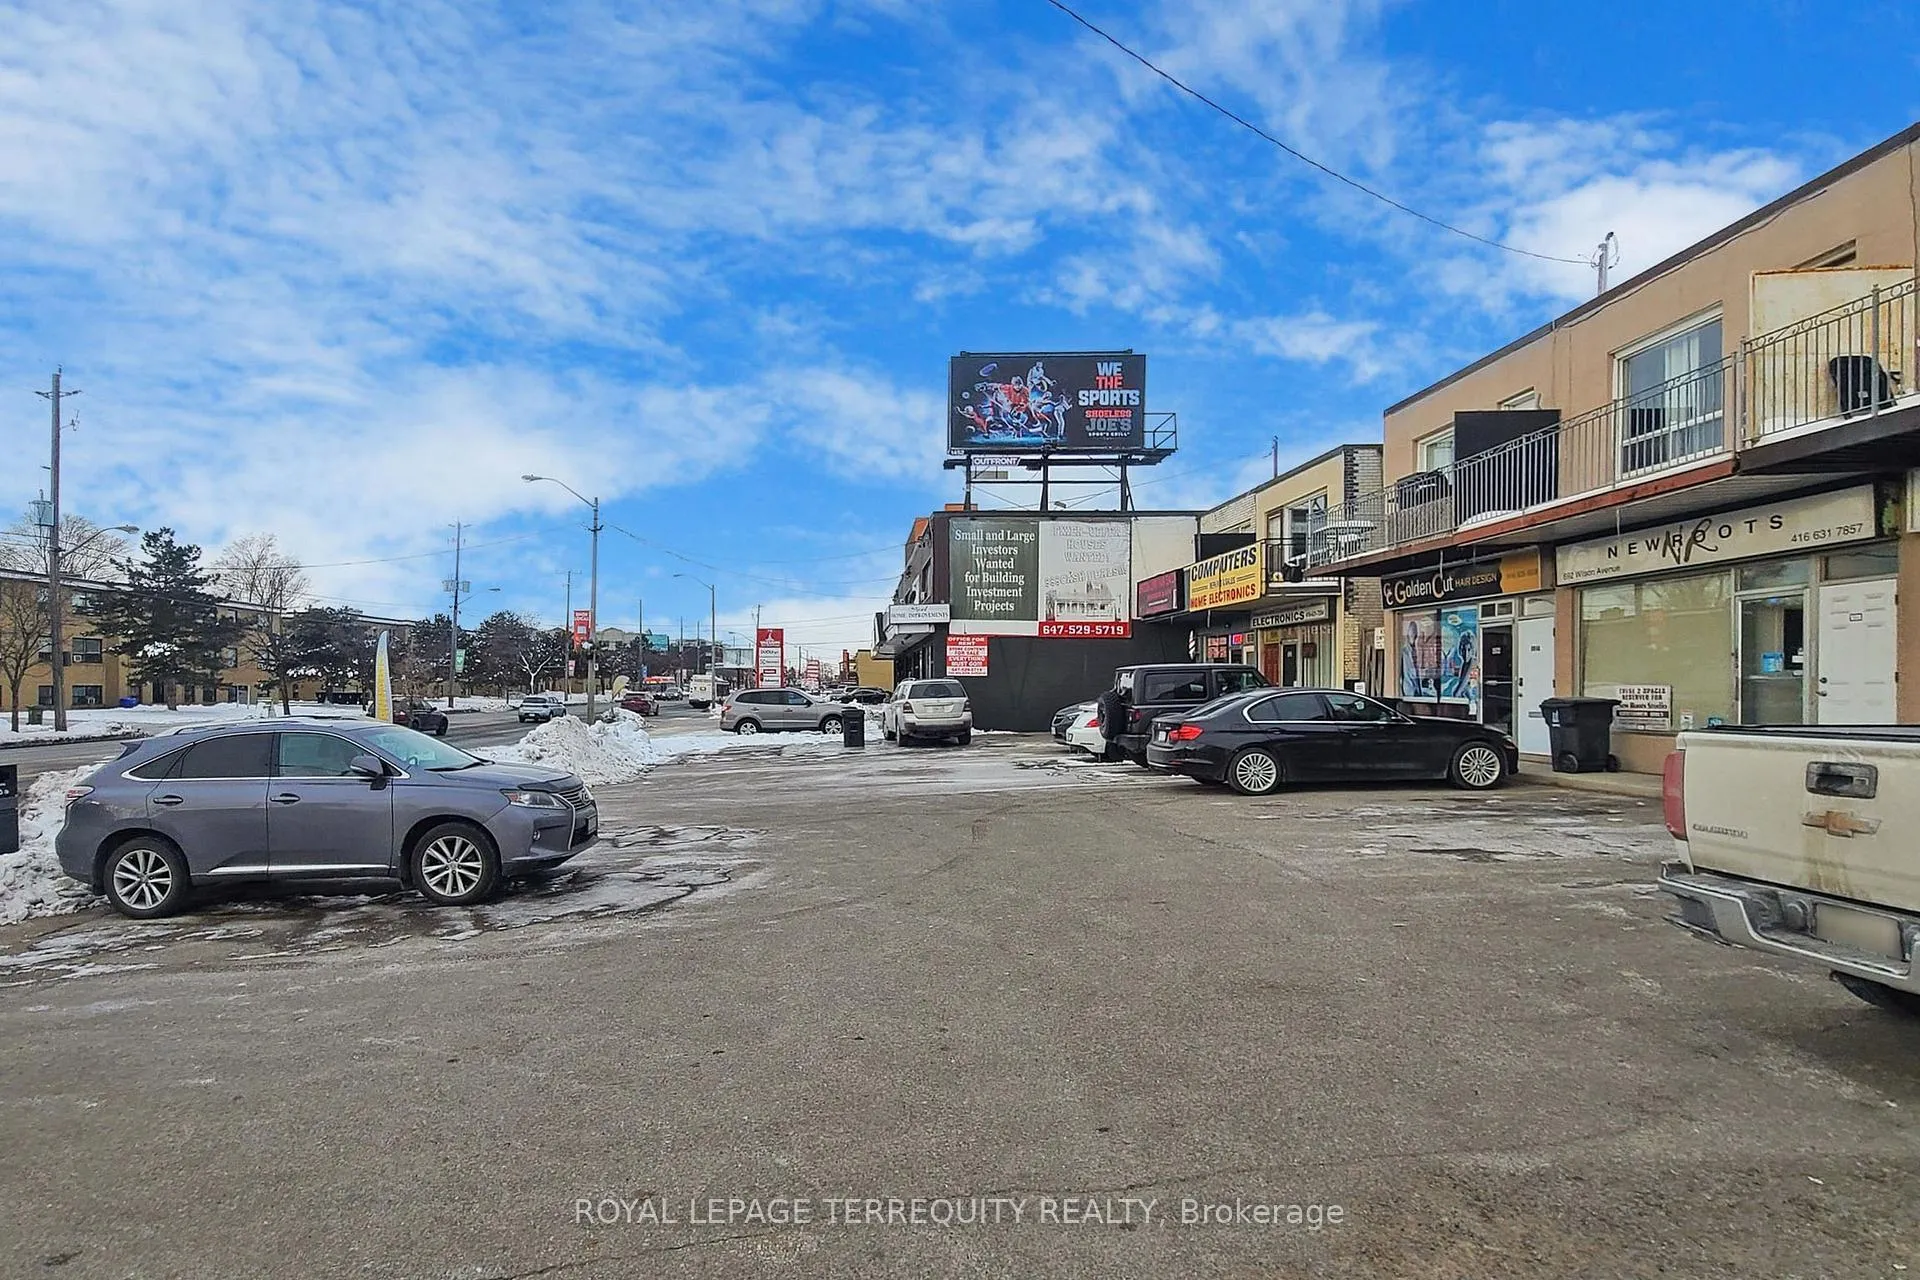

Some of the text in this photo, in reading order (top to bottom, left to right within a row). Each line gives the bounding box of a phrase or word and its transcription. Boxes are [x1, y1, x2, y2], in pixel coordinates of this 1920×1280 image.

[1096, 362, 1122, 376] WE
[1095, 376, 1123, 390] THE
[1078, 389, 1140, 406] SPORTS
[1085, 409, 1132, 418] SHOELESS
[1085, 418, 1132, 432] JOE'S
[954, 529, 1036, 544] Small and Large
[1791, 523, 1863, 543] 416 631 7857
[971, 543, 1019, 555] Investors
[1607, 537, 1660, 559] NEW
[975, 557, 1015, 569] Wanted
[1191, 547, 1257, 582] COMPUTERS
[964, 571, 1025, 586] for Building
[1454, 577, 1471, 588] HAIR
[1472, 572, 1498, 585] DESIGN
[966, 586, 1023, 597] Investment
[1191, 583, 1257, 609] HOME ELECTRONICS
[974, 599, 1015, 614] Projects
[1252, 610, 1305, 627] ELECTRONICS
[1042, 625, 1124, 635] 647-529-5719
